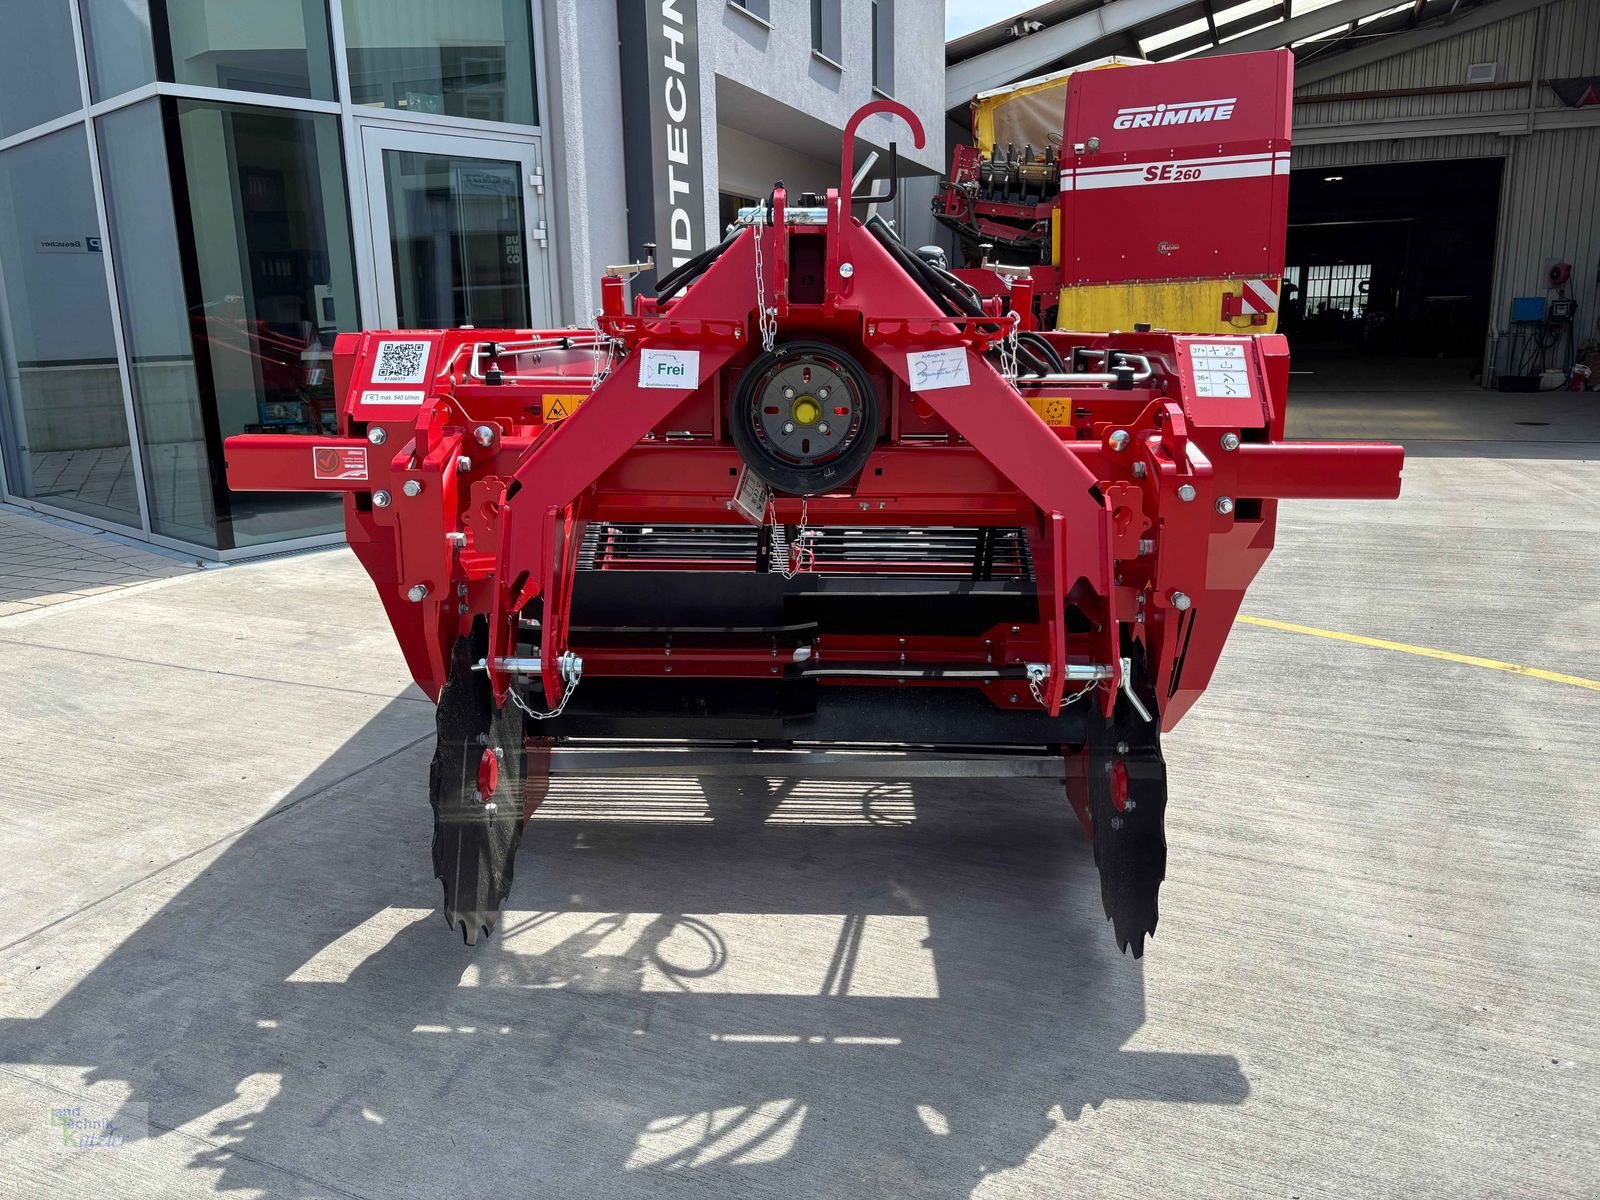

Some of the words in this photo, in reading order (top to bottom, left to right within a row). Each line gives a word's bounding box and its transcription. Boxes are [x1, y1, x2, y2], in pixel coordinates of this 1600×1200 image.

[1113, 102, 1236, 130] GRIMME
[657, 363, 685, 376] Frei
[914, 358, 963, 385] 377
